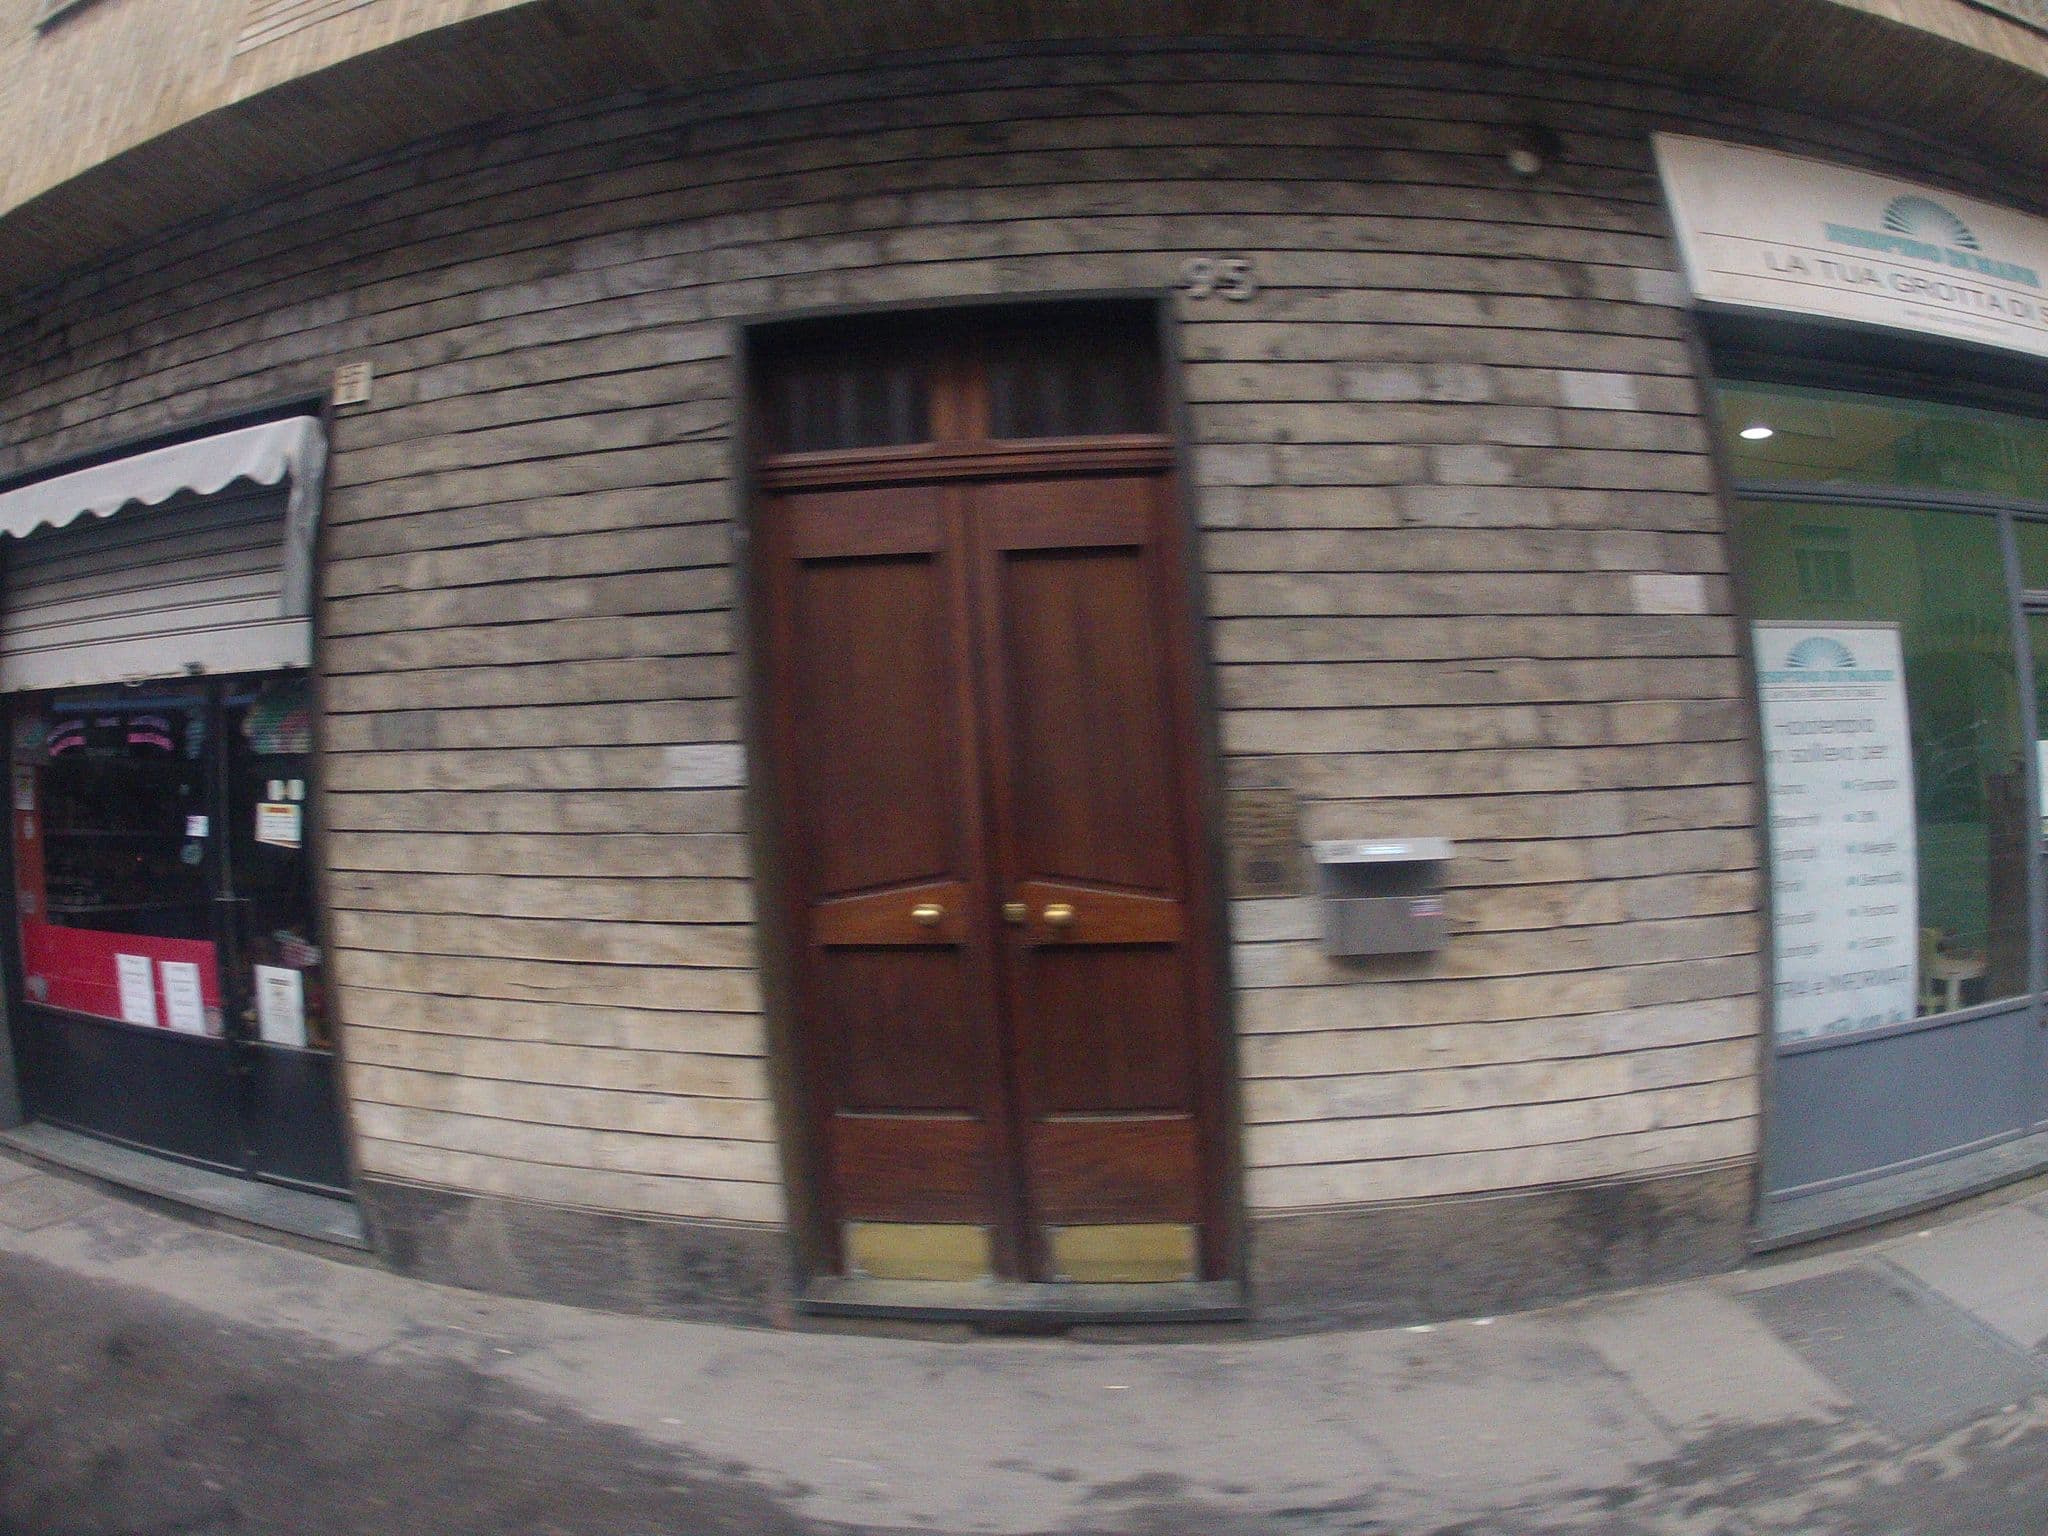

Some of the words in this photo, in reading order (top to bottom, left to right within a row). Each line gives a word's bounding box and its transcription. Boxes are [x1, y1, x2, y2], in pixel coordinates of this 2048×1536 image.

[1764, 250, 1810, 277] LA
[1813, 258, 1884, 287] TUA
[1885, 272, 2006, 312] GROTTA
